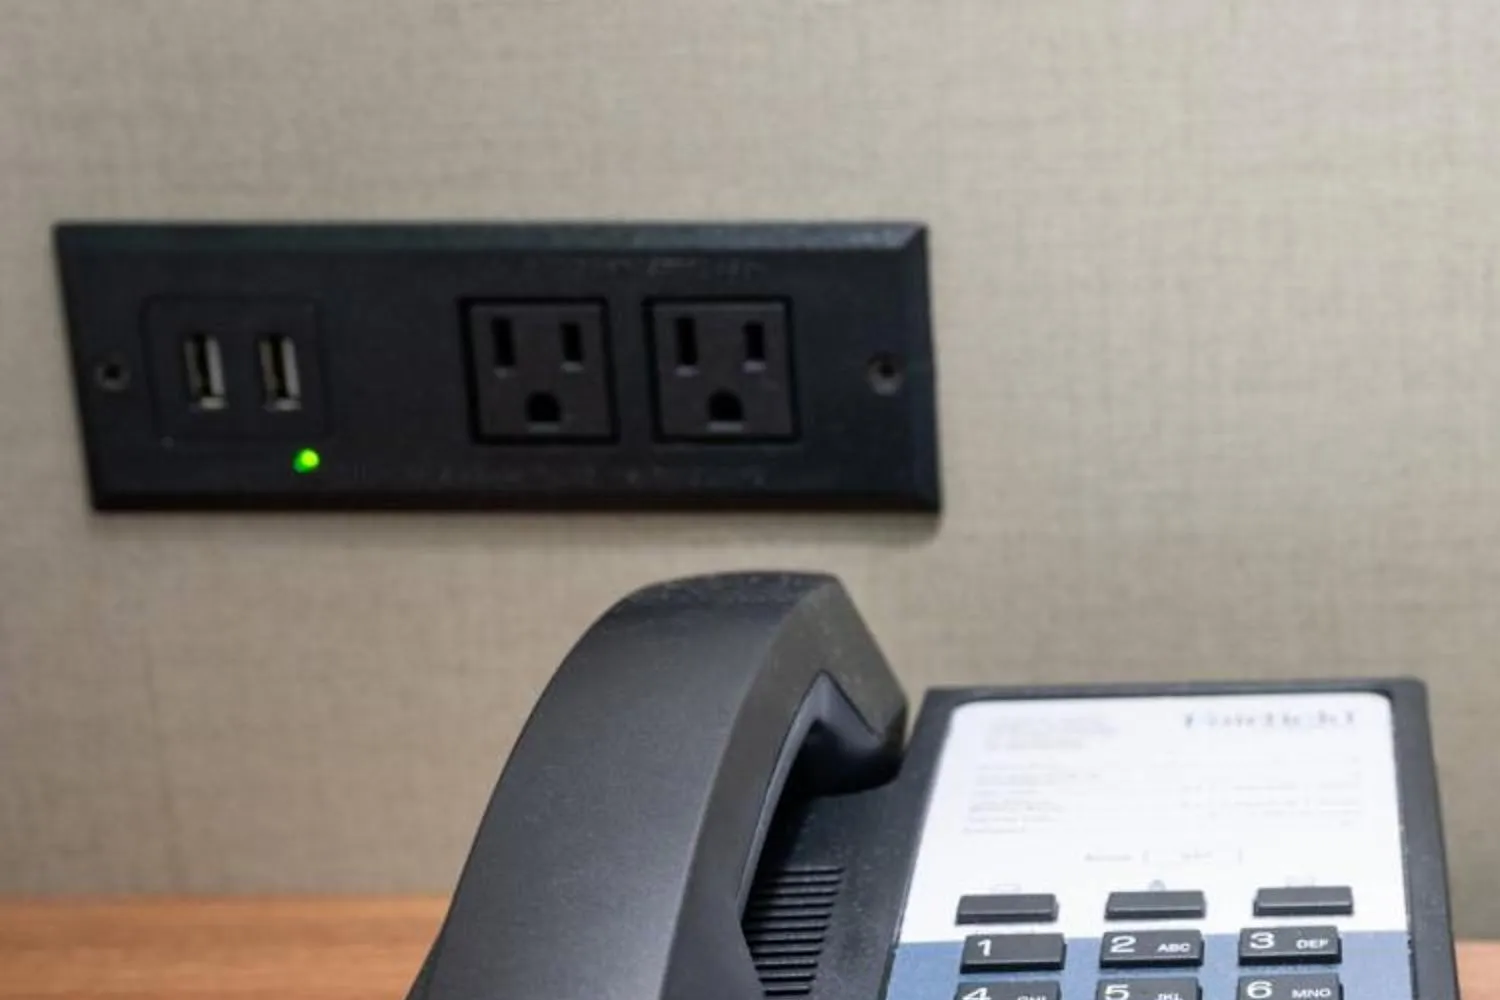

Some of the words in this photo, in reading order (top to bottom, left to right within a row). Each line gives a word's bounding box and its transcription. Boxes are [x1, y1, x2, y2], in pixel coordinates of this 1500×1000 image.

[976, 940, 992, 956] 1
[1110, 936, 1138, 954] 2
[1156, 942, 1192, 954] ABC
[1249, 932, 1276, 950] 3
[1295, 937, 1330, 950] DEF
[1245, 980, 1274, 999] 6
[1291, 987, 1332, 1000] MNO
